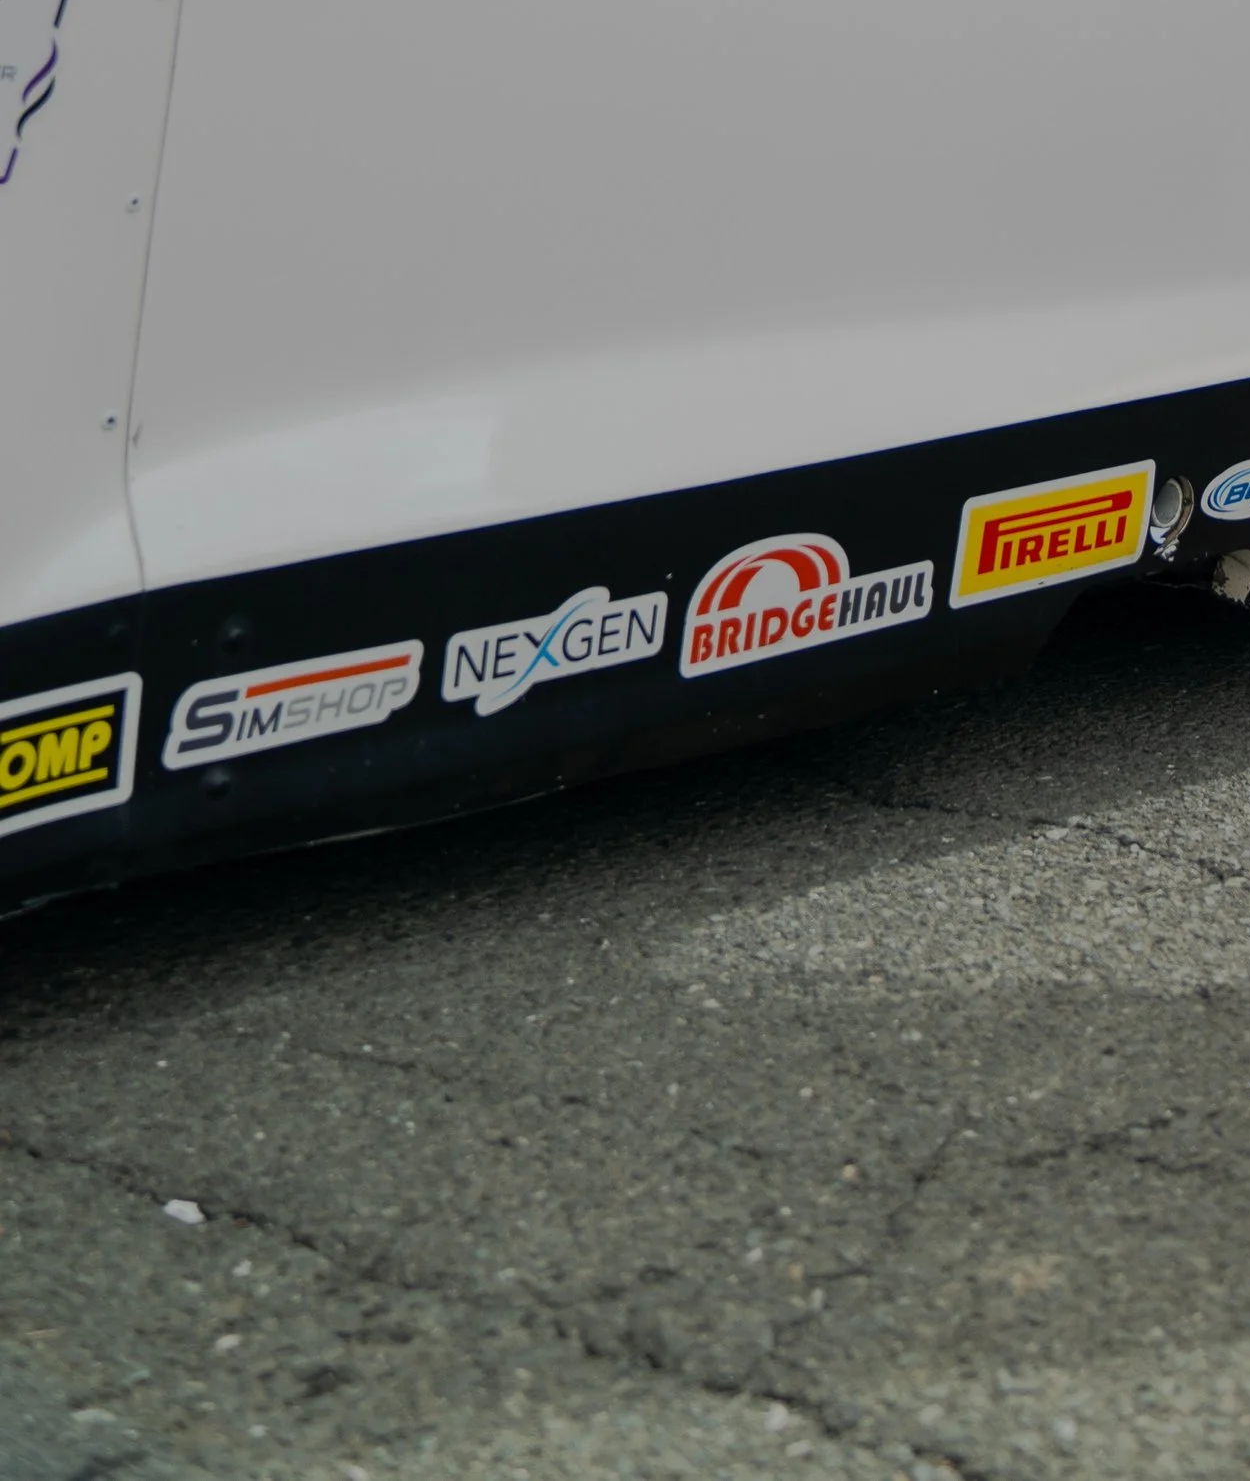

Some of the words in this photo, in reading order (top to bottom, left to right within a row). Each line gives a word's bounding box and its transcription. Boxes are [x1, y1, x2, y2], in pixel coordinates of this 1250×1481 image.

[977, 489, 1133, 576] PIRELLI
[454, 601, 659, 691] NEXGEN
[690, 571, 926, 665] BRIDGEHAUL
[0, 720, 113, 791] OMP
